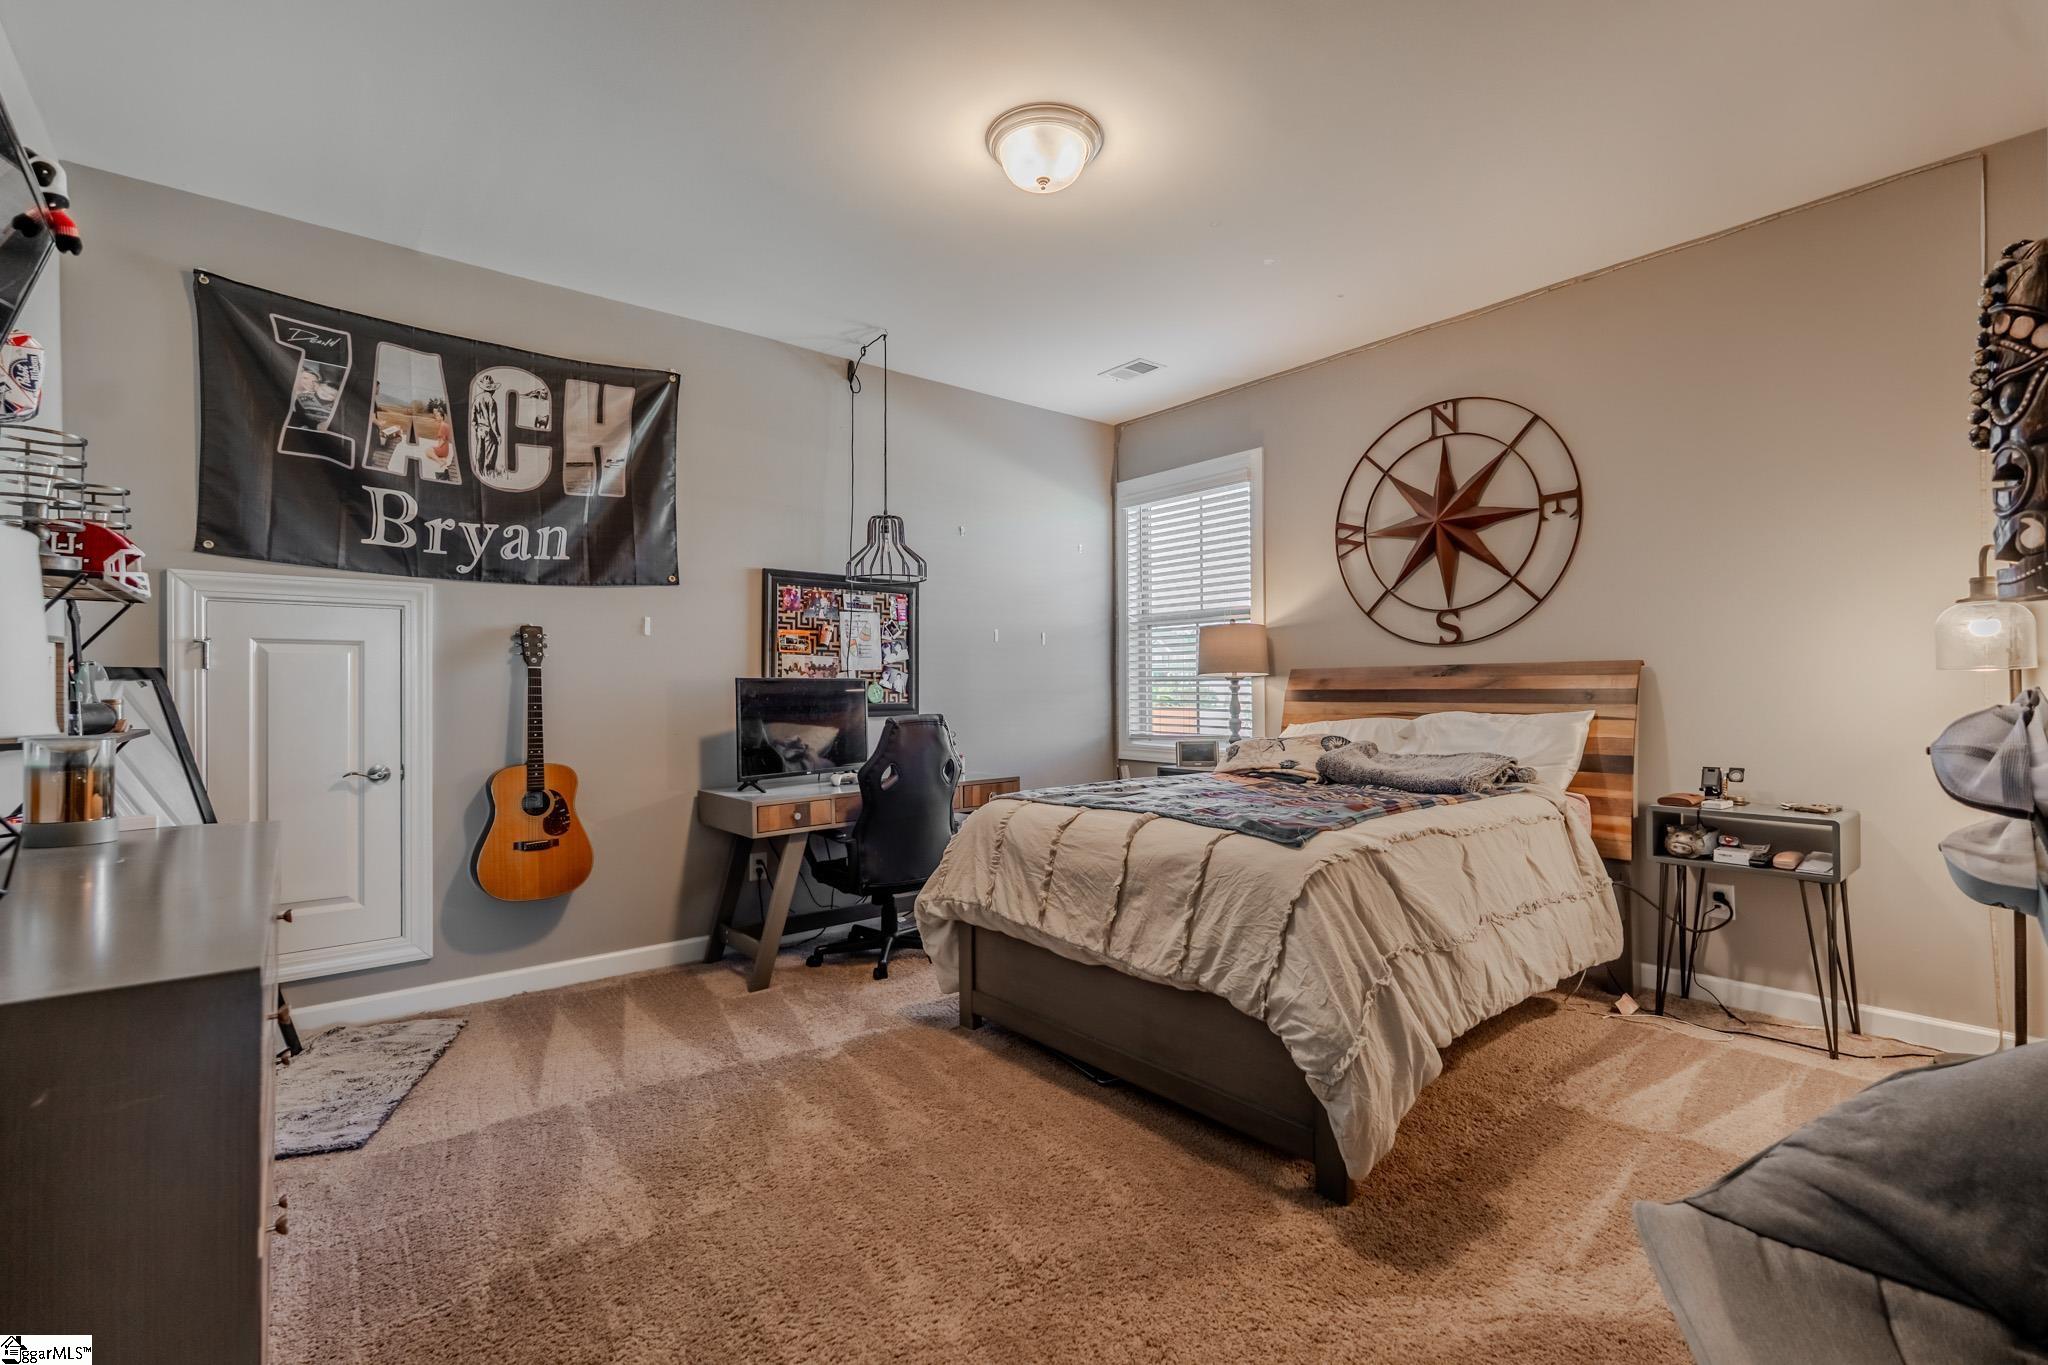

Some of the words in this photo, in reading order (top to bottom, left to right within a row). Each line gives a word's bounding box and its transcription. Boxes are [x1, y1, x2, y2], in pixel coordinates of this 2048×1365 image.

[269, 313, 635, 498] ZACH
[1428, 401, 1459, 440] N
[1538, 485, 1580, 521] E
[360, 485, 570, 574] Bryan
[1436, 609, 1462, 645] S
